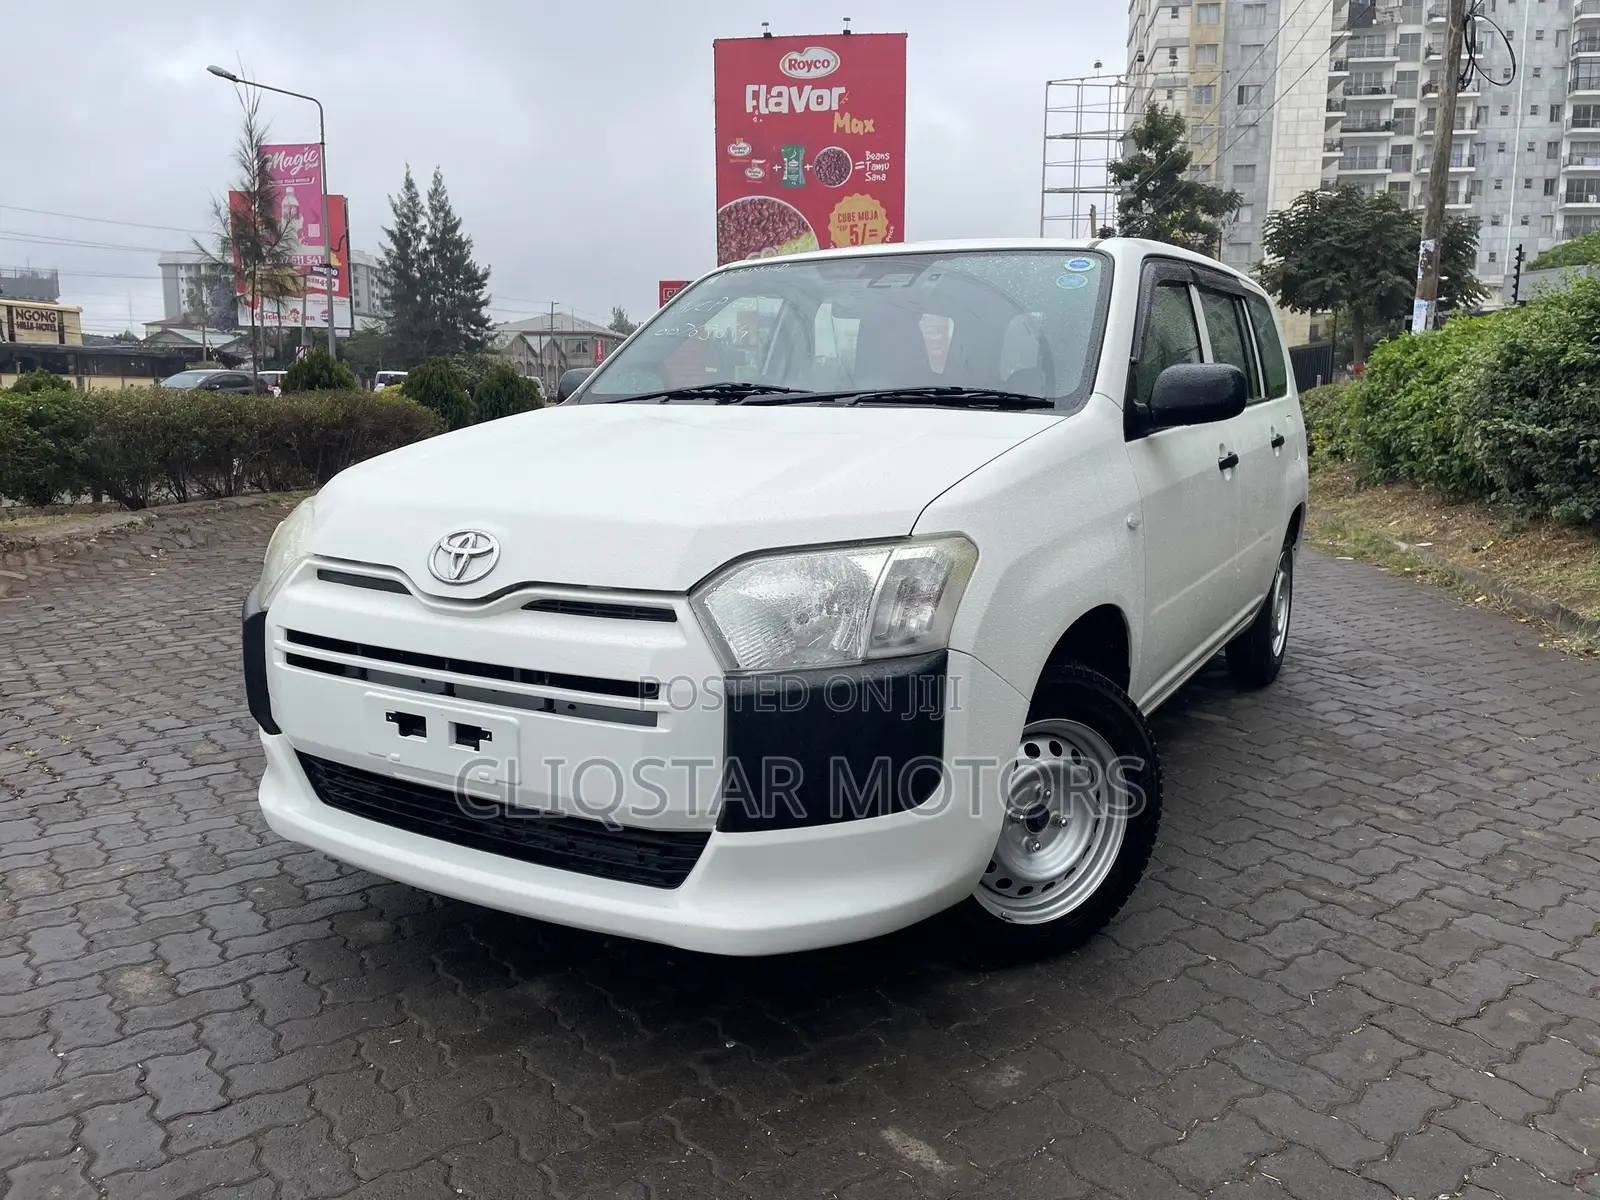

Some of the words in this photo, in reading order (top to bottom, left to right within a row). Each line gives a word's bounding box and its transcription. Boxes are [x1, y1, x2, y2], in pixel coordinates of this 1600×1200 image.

[788, 58, 831, 73] Royco
[745, 84, 846, 115] Flavor
[833, 111, 875, 135] Max
[261, 147, 319, 176] Magic
[865, 150, 890, 160] Beans
[865, 171, 886, 182] Sana
[837, 212, 856, 224] CUBE
[858, 209, 879, 221] MOJA
[307, 256, 322, 265] 541
[15, 307, 57, 323] NGONG
